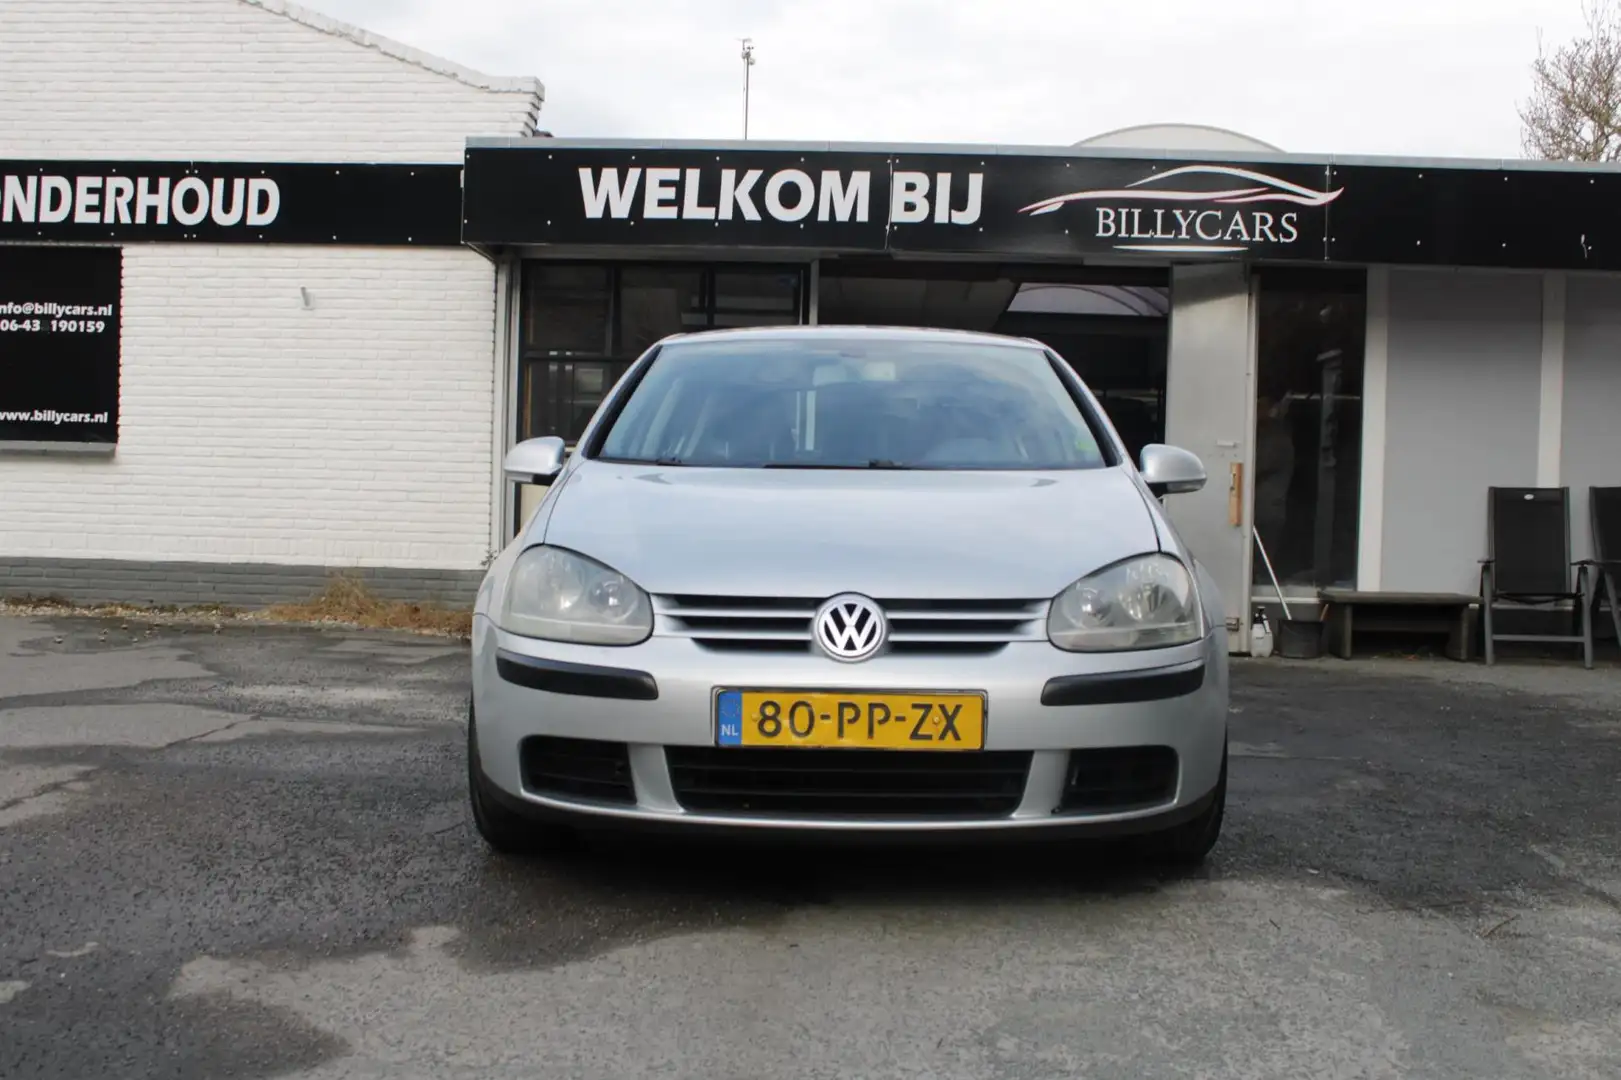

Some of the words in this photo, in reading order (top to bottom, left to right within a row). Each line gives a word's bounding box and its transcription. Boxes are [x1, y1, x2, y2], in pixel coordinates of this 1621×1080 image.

[0, 175, 280, 226] NDERHOUD
[578, 167, 871, 223] WELKOM
[891, 171, 984, 226] BIJ
[1096, 207, 1298, 243] BILLYCARS
[0, 302, 113, 318] nfo@billycars.nl
[0, 319, 41, 332] 06-43
[51, 320, 105, 332] 190159
[720, 724, 738, 737] NL
[757, 700, 963, 742] 80-PP-ZX
